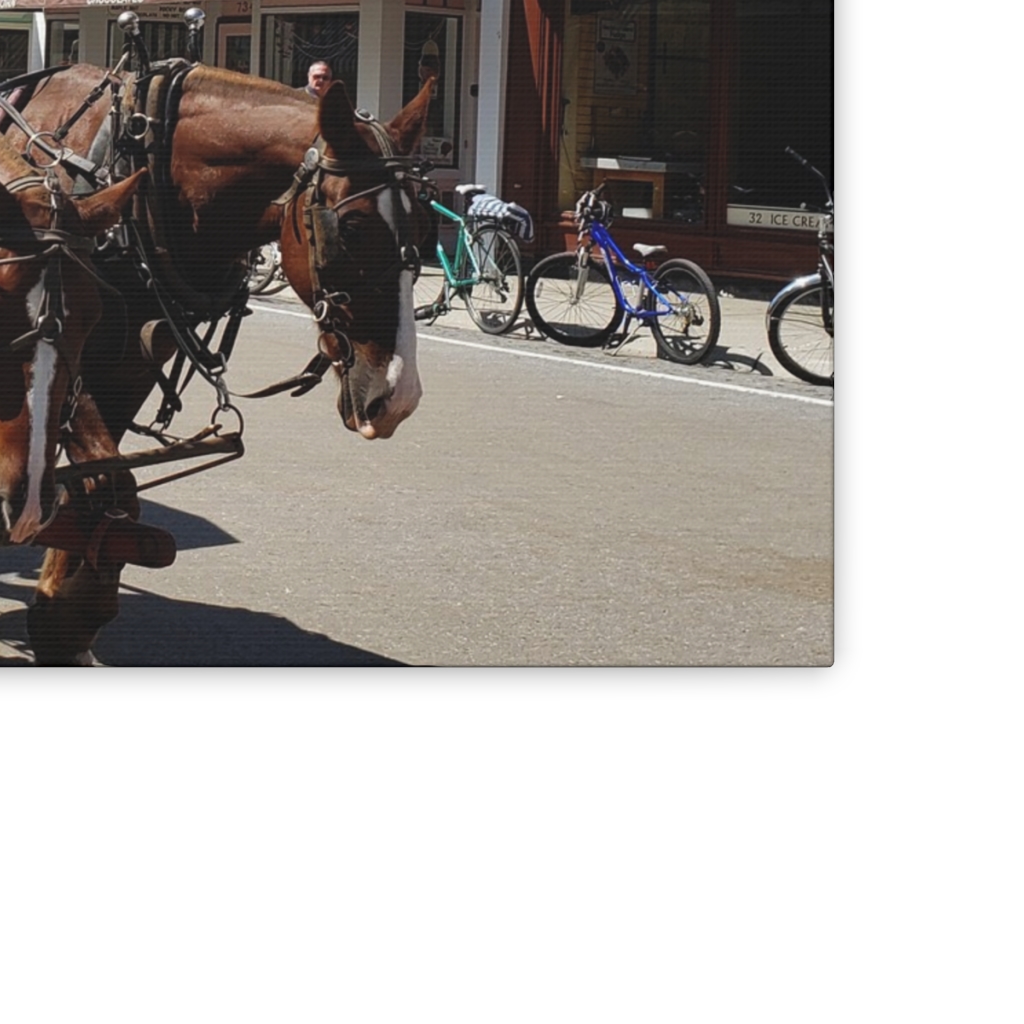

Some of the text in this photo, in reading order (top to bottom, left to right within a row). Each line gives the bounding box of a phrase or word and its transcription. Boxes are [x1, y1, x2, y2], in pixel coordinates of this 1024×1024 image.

[749, 212, 828, 229] 32 ICE CRE
